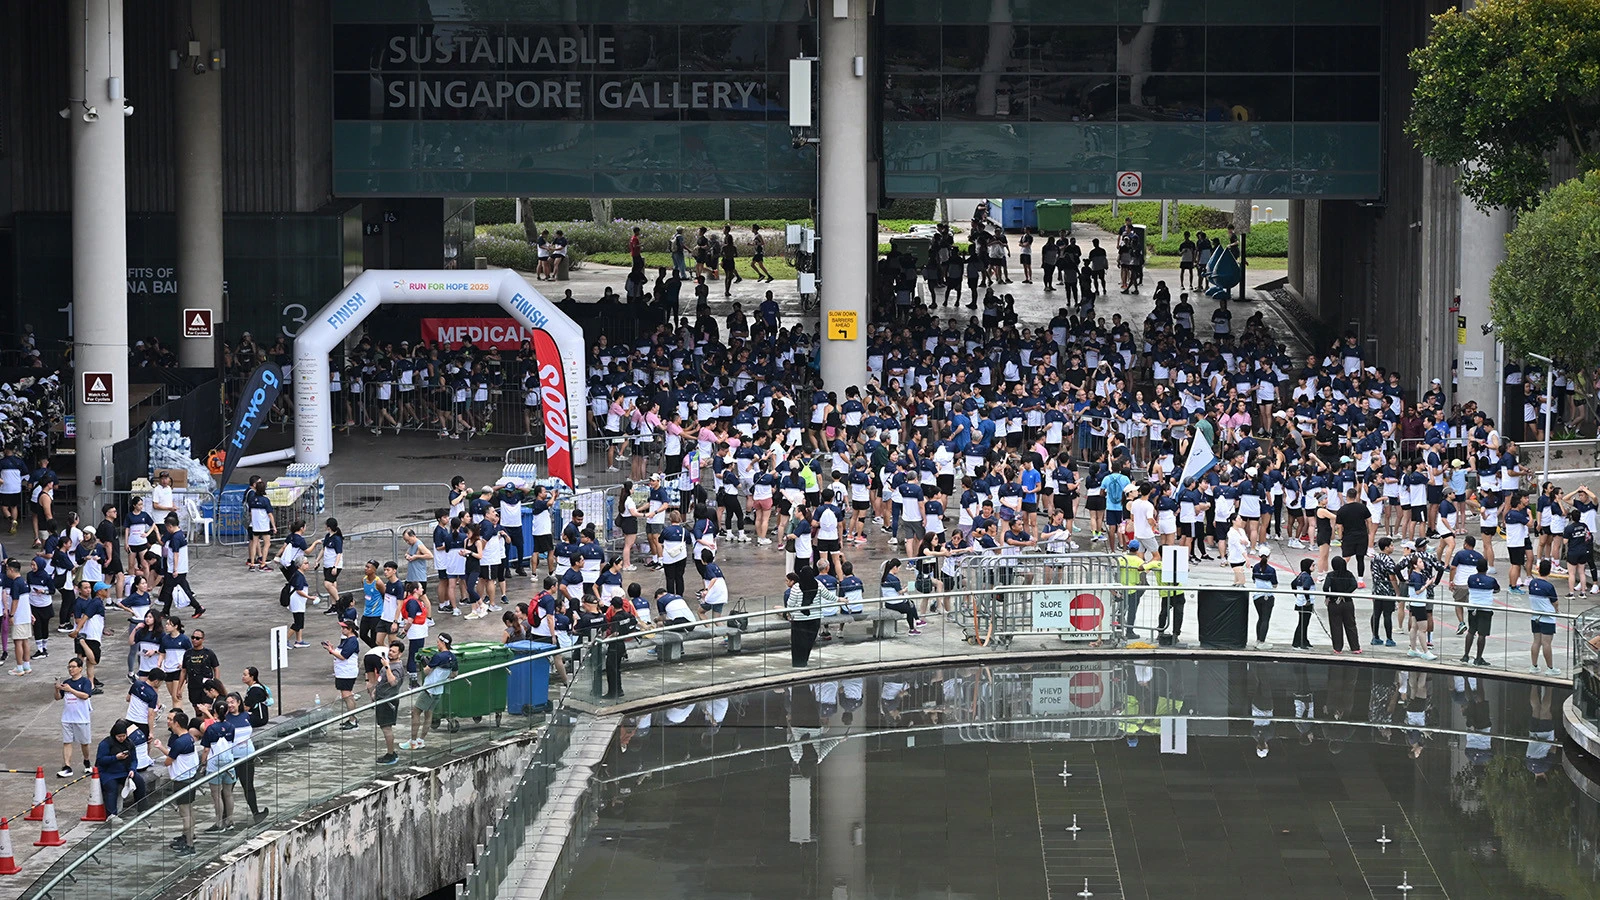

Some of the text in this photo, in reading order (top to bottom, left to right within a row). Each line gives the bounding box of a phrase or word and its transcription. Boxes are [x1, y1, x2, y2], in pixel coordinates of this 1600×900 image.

[389, 36, 615, 64] SUSTAINABLE
[388, 80, 756, 109] SINGAPORE GALLERY
[127, 267, 174, 278] FITS OF
[470, 283, 489, 291] 2025
[282, 303, 308, 338] 3
[327, 292, 366, 329] FINISH
[510, 292, 549, 328] FINISH
[438, 326, 531, 343] MEDICAL
